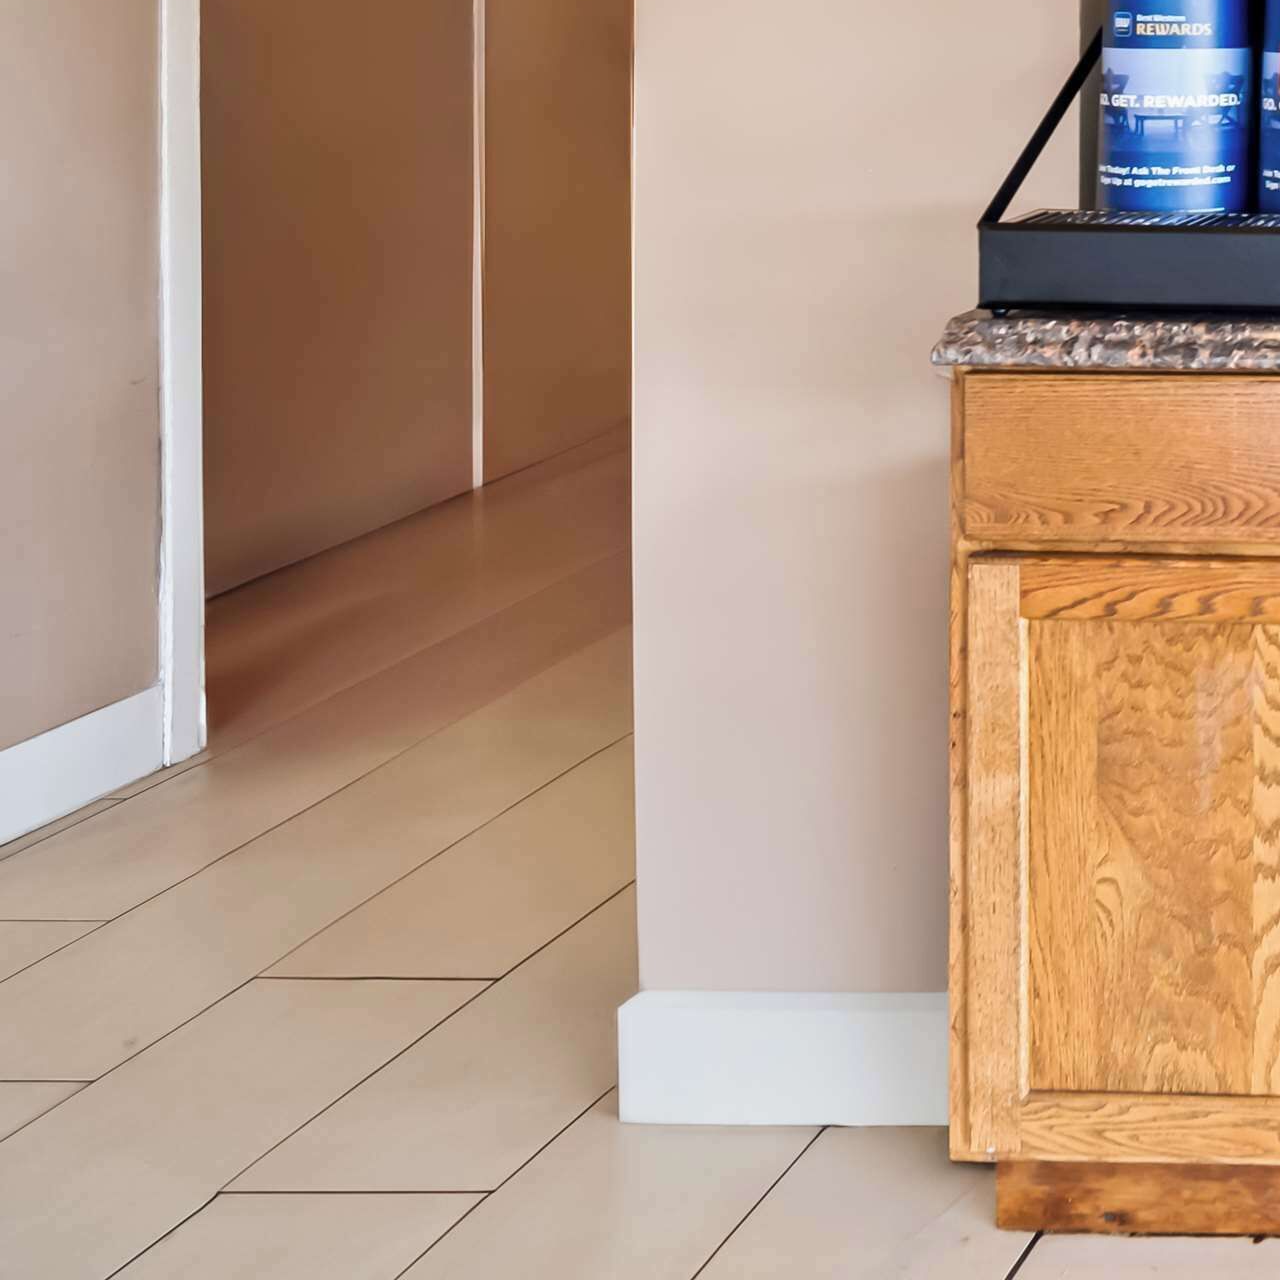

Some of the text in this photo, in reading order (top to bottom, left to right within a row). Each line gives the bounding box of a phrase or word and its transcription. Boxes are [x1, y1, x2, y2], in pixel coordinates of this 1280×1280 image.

[1136, 23, 1213, 36] REWARDS
[1111, 94, 1141, 108] GET.
[1143, 93, 1241, 108] REWARDED.
[1132, 166, 1149, 175] Ask
[1150, 166, 1171, 175] The
[1172, 166, 1201, 175] Front
[1202, 164, 1225, 174] Desk
[1133, 176, 1231, 188] gogetrewarded.com
